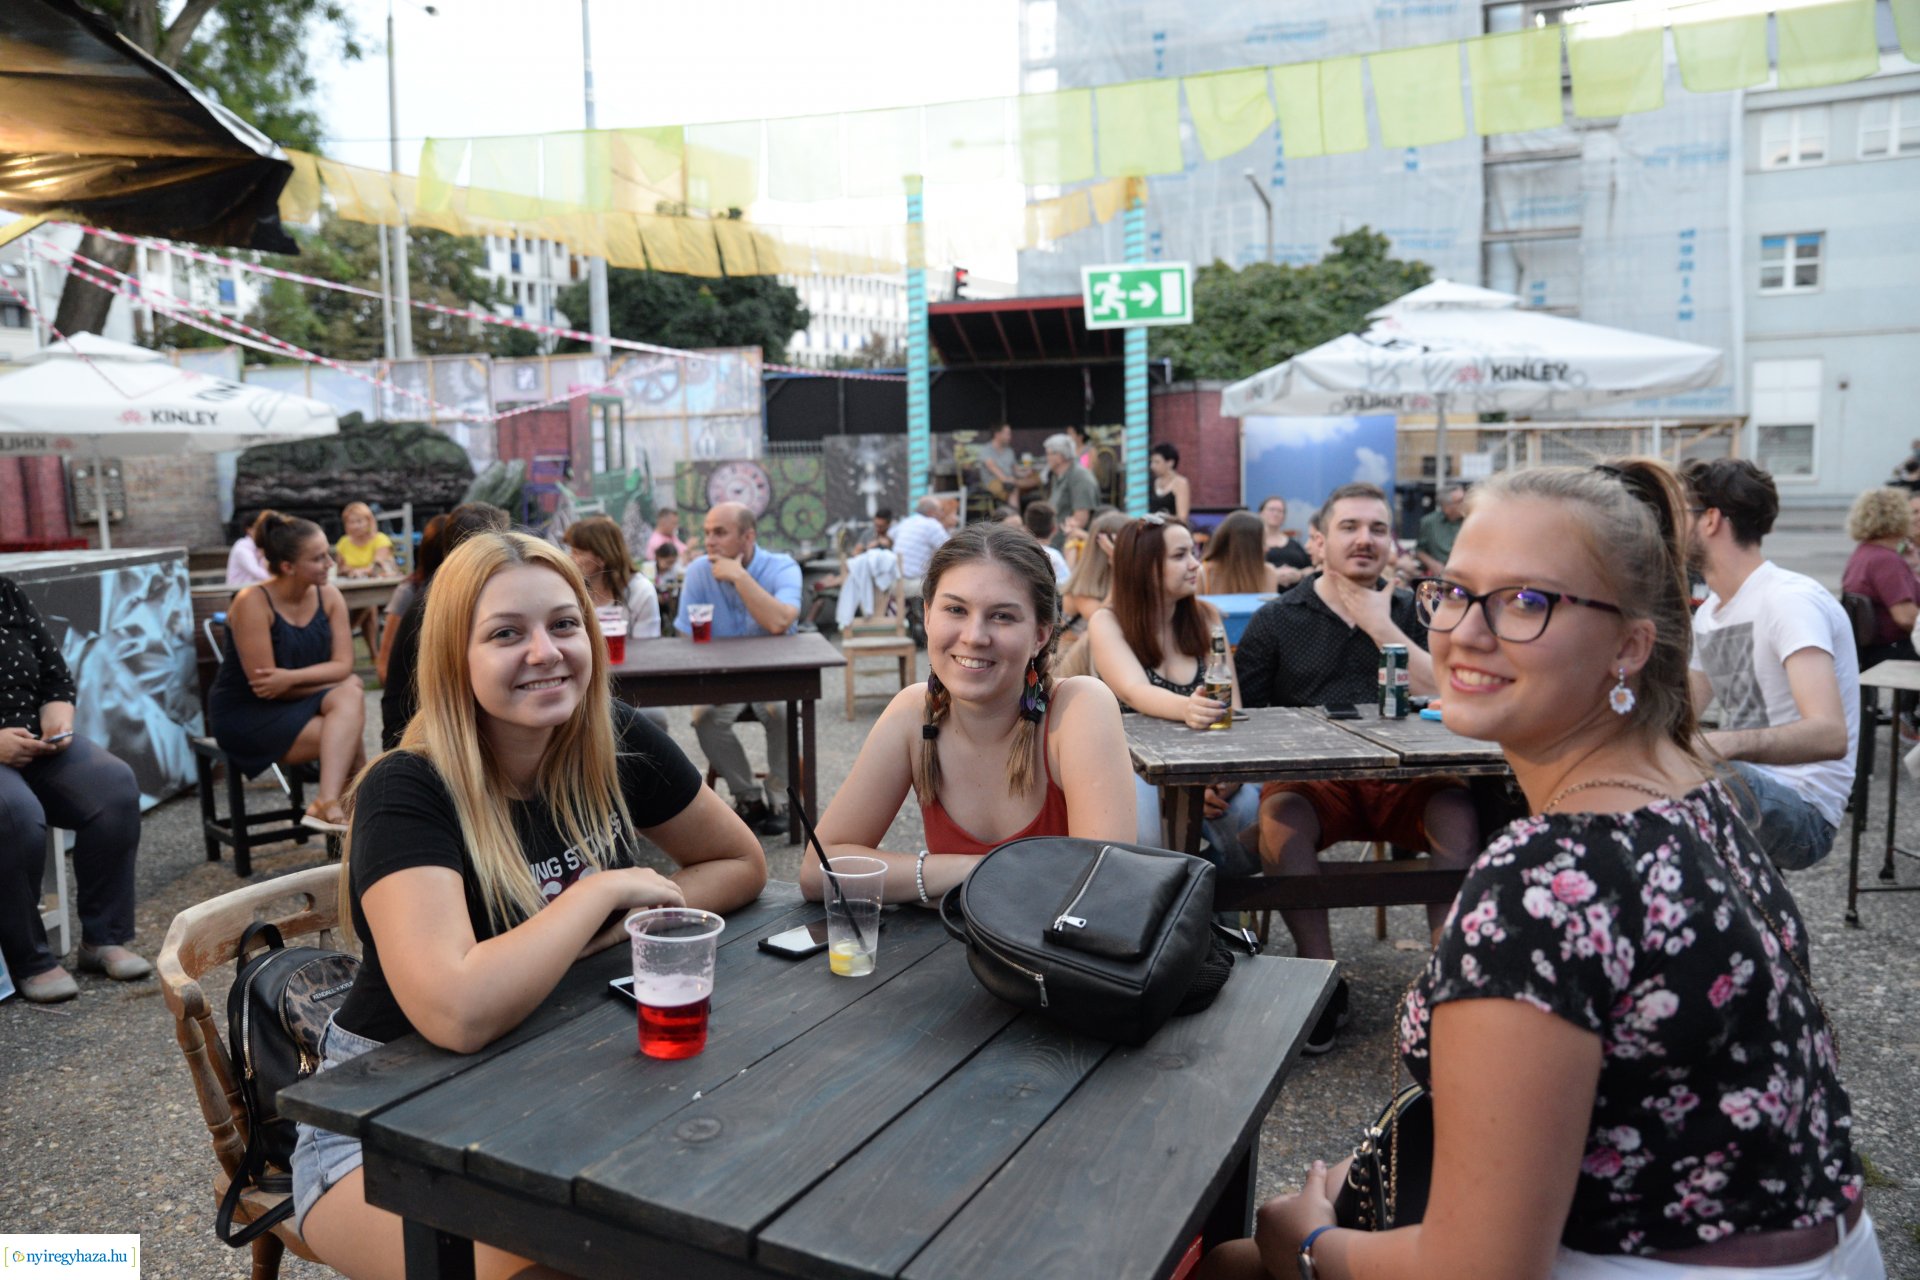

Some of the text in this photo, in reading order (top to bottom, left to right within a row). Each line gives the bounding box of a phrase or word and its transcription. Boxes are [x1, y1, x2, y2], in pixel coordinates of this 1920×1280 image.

[1491, 363, 1569, 382] KINLEY
[150, 410, 218, 426] KINLEY
[312, 988, 337, 1000] KENDALL
